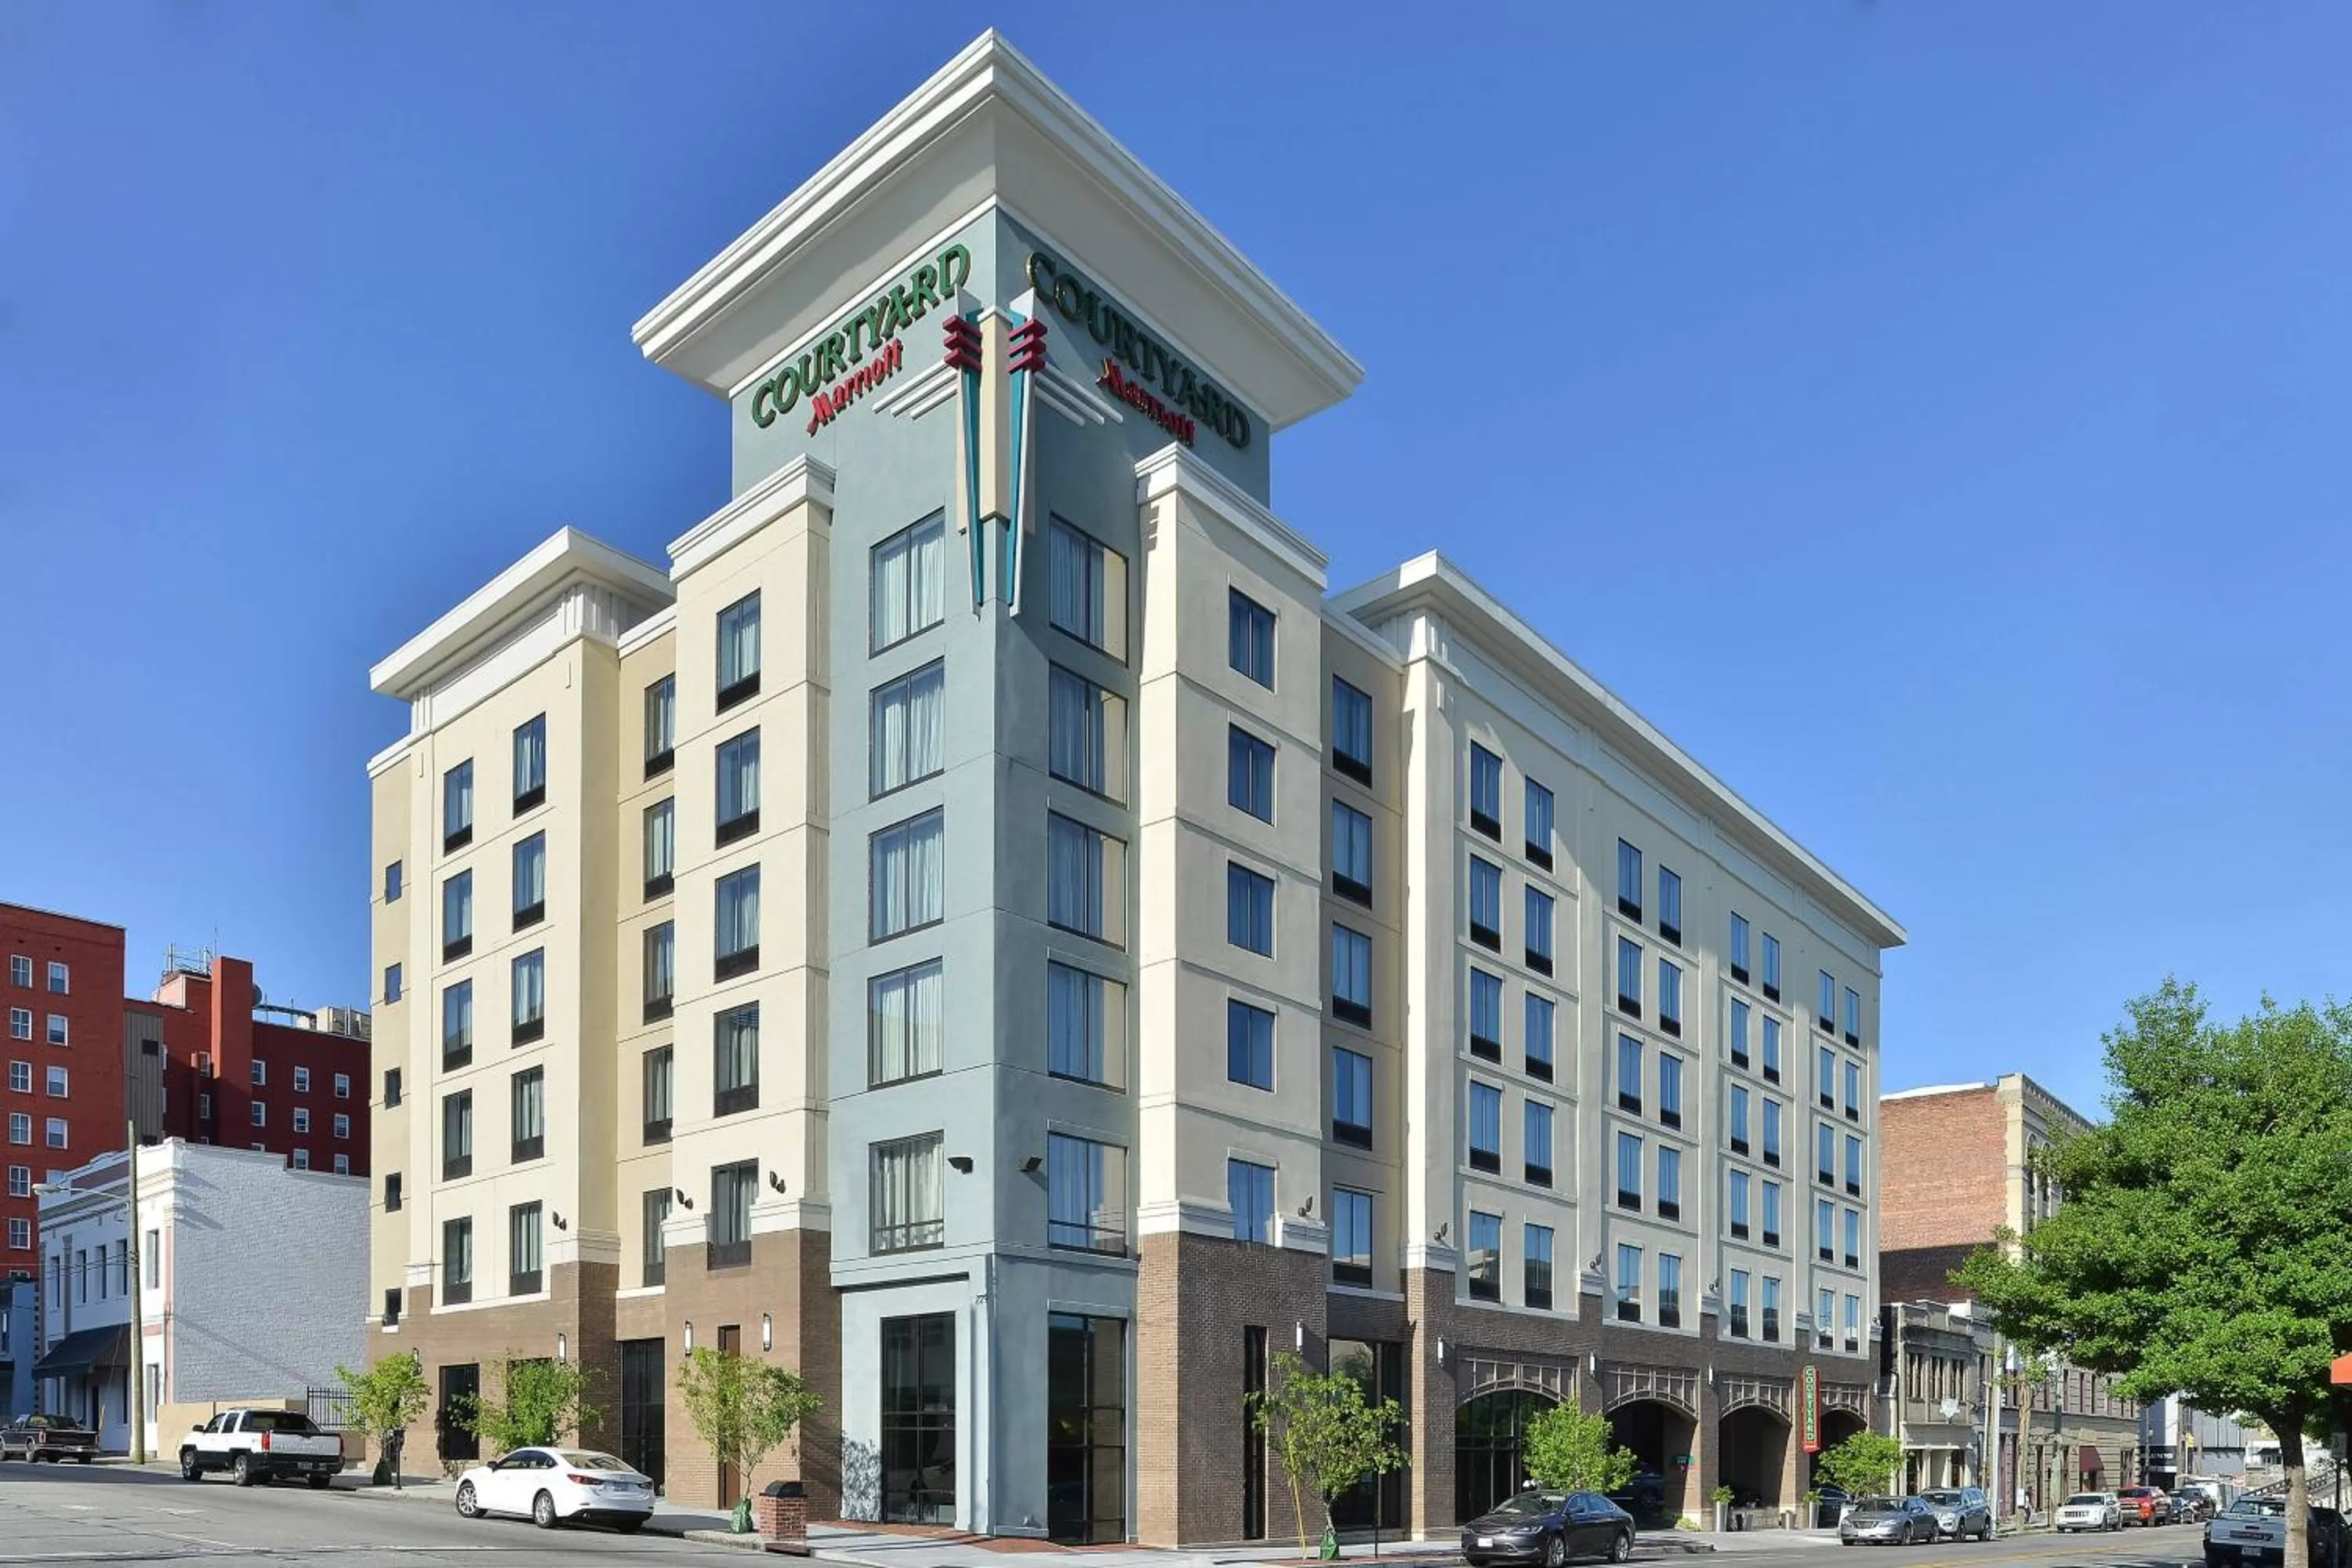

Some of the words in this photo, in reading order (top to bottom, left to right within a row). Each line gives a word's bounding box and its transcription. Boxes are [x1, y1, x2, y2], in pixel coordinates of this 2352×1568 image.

[752, 244, 971, 428] COURTYARD
[1026, 252, 1250, 448] COURTYARD
[807, 338, 903, 437] Marriott
[1095, 358, 1196, 447] Marriott
[1806, 1367, 1814, 1441] COURTYARD
